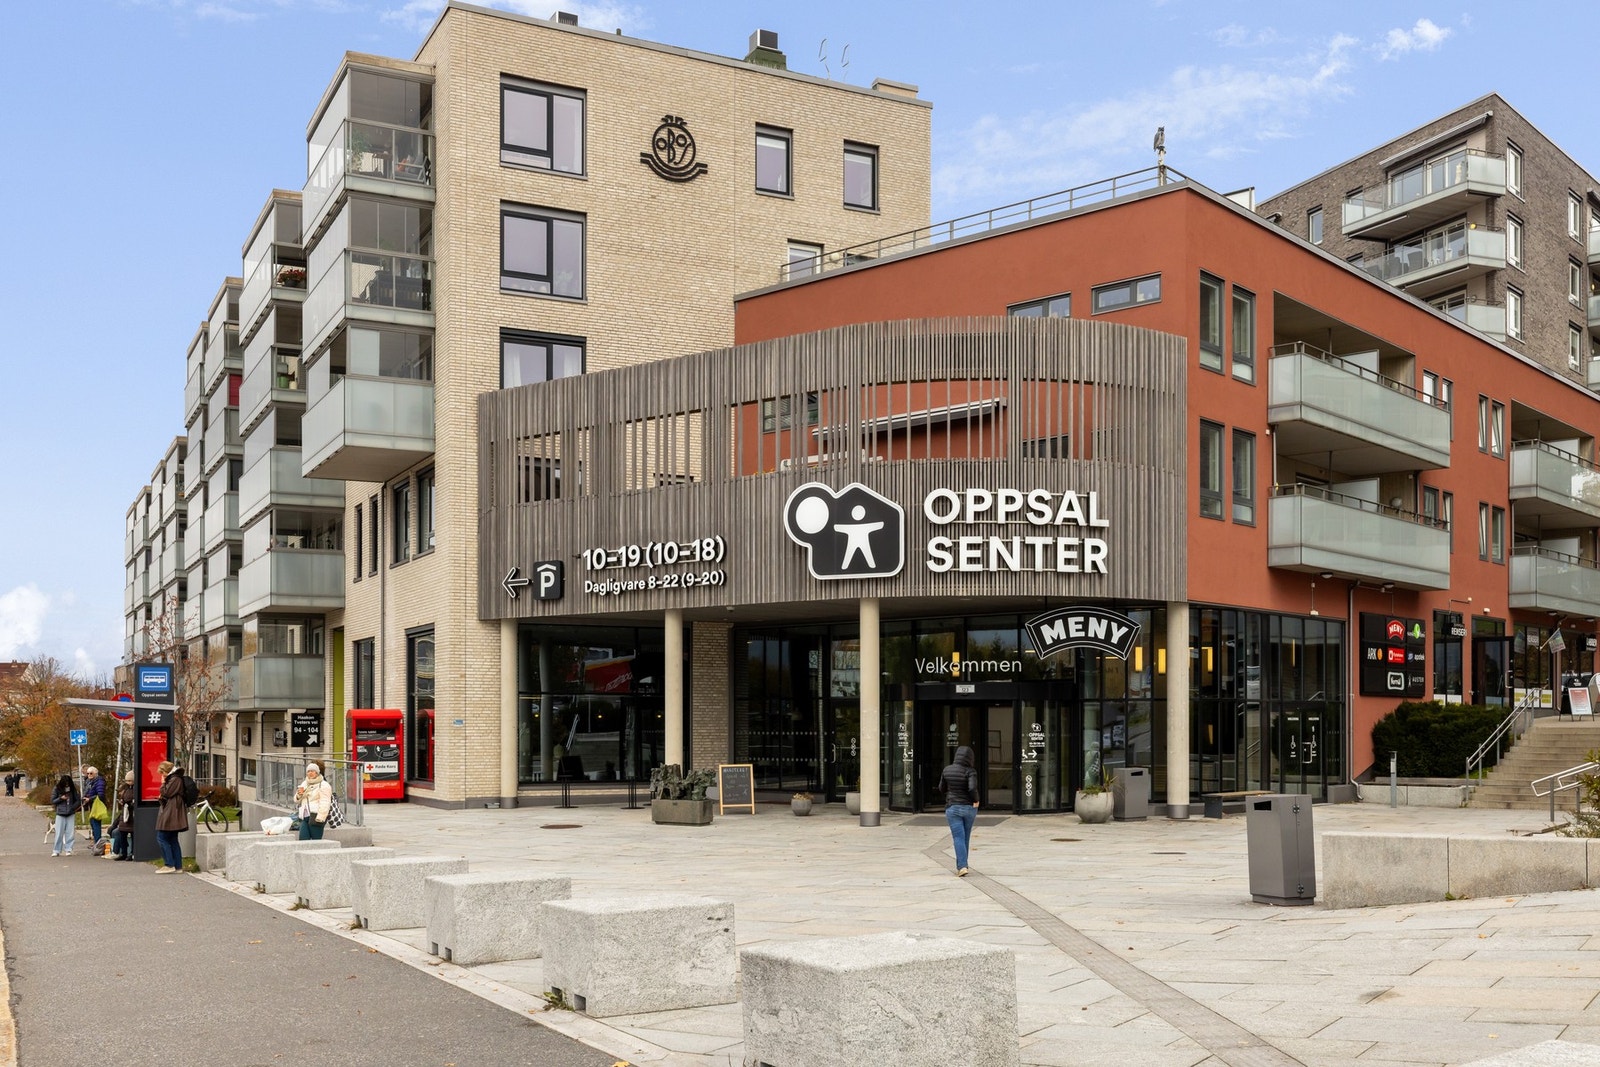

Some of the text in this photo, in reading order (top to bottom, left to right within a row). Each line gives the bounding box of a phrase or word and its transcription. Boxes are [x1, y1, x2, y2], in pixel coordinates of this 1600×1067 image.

[923, 487, 1110, 528] OPPSAL
[582, 534, 726, 571] 10-19 (10-18)
[926, 535, 1109, 574] SENTER
[539, 570, 556, 598] P
[584, 569, 726, 596] Dagligvare 8-22 (9-20)
[1039, 616, 1130, 646] MENY
[1388, 622, 1404, 635] MENY
[914, 656, 1022, 674] Velkommen
[1367, 647, 1377, 660] ARK
